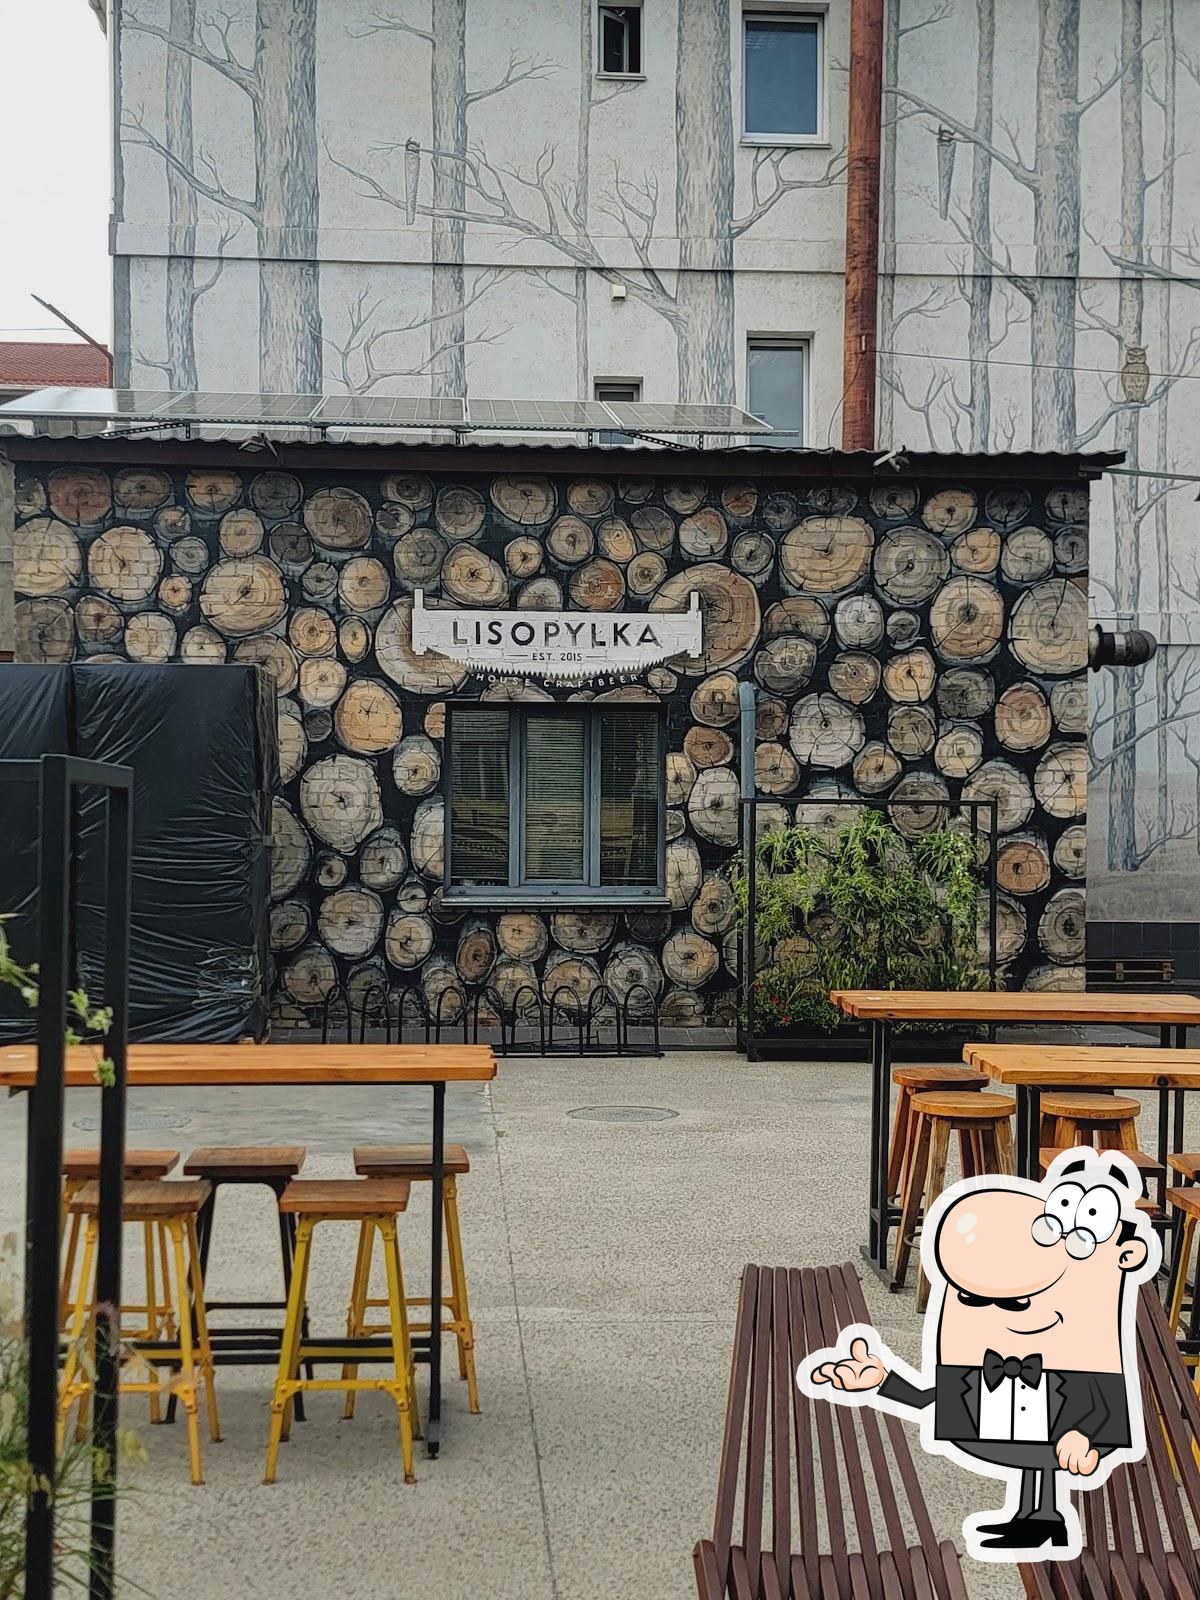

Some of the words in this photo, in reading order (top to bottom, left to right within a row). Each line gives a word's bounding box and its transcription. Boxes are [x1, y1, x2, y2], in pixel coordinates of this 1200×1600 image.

[452, 621, 663, 648] LISOPYLKA
[532, 652, 556, 661] EST.
[560, 652, 582, 662] 2015
[475, 673, 532, 687] HOUSE
